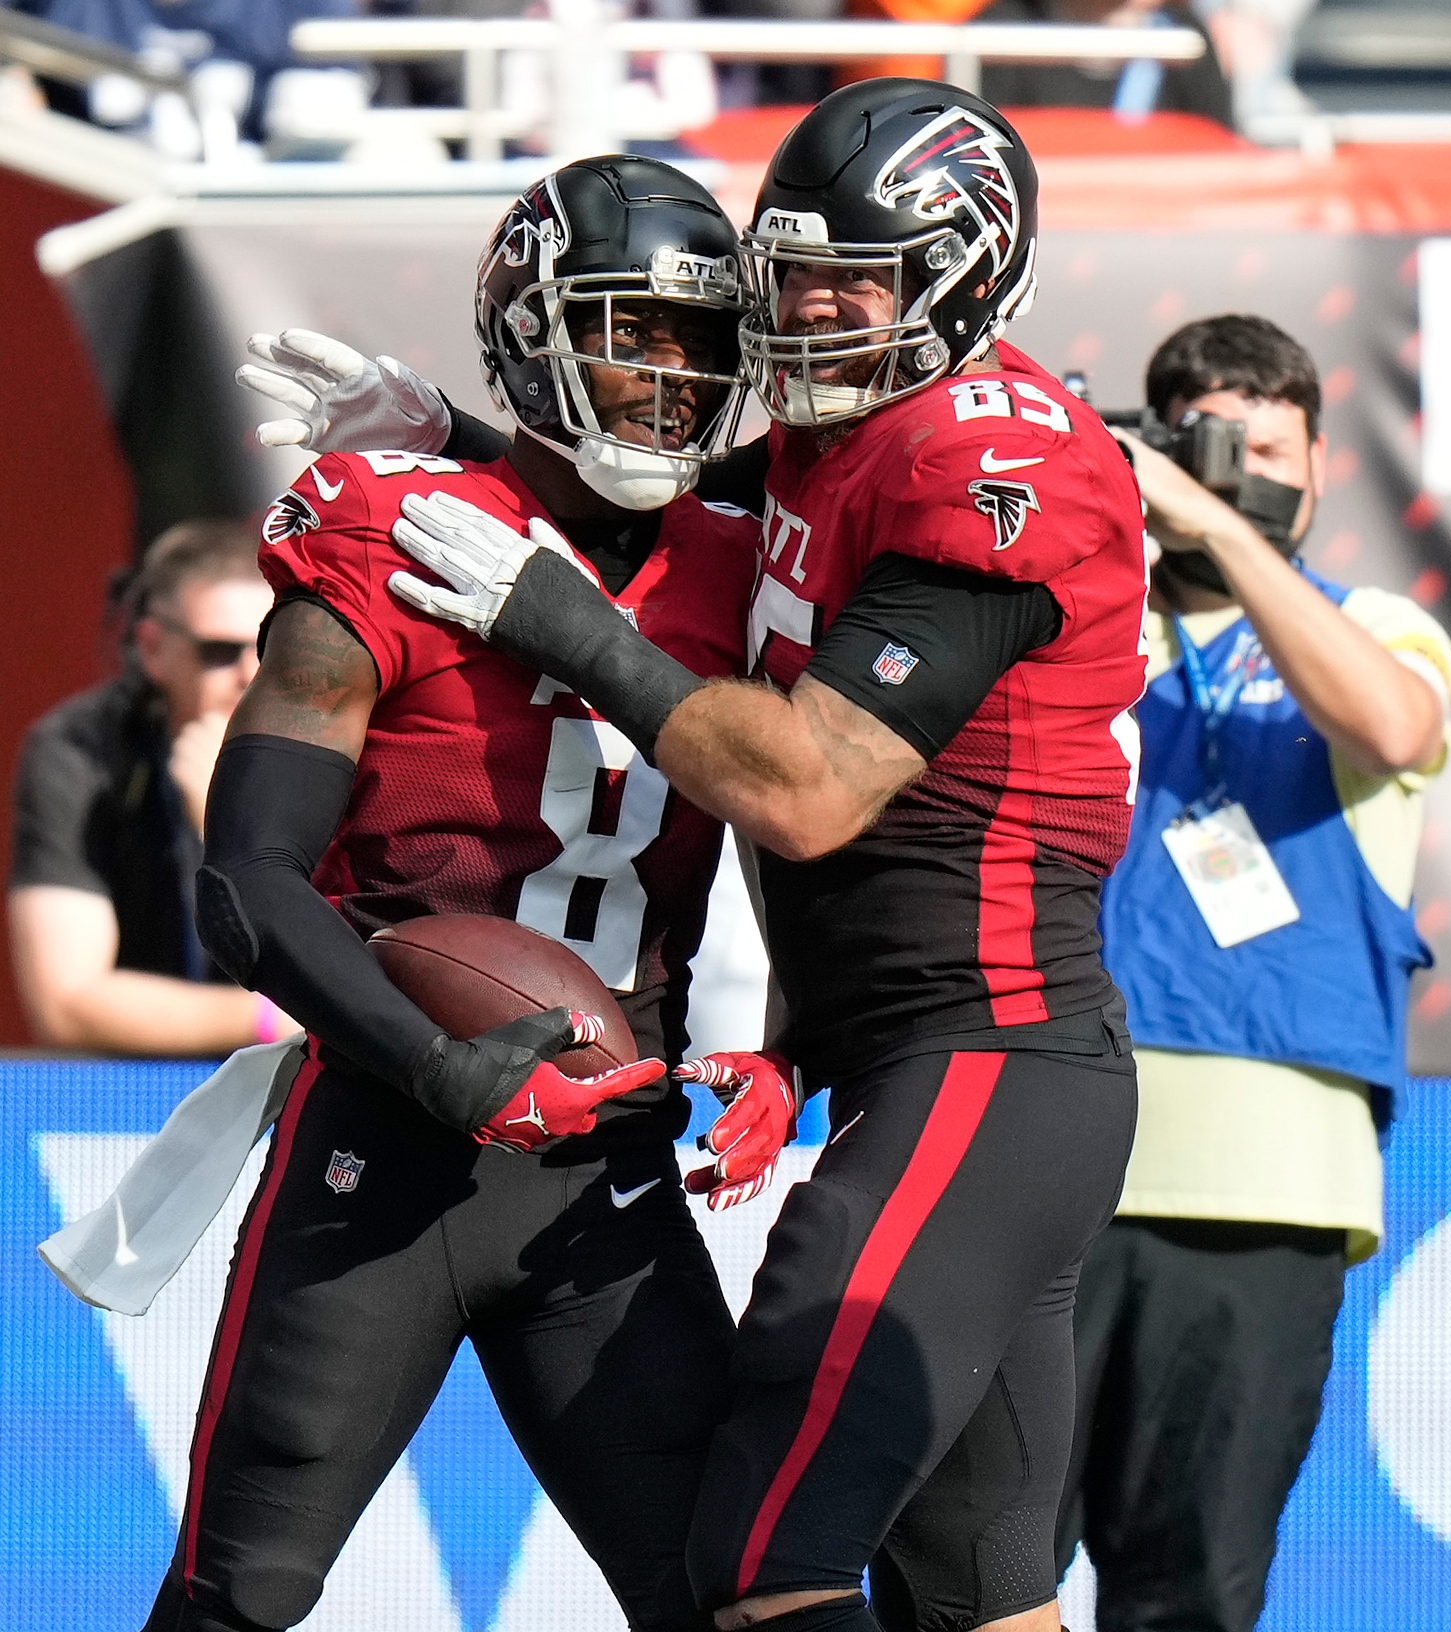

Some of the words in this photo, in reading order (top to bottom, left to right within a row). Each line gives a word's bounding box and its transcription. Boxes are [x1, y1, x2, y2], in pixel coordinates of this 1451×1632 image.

[768, 216, 802, 233] ATL
[677, 261, 716, 280] ATL
[877, 656, 904, 680] NFL
[515, 716, 670, 993] 8
[331, 1165, 354, 1187] NFL
